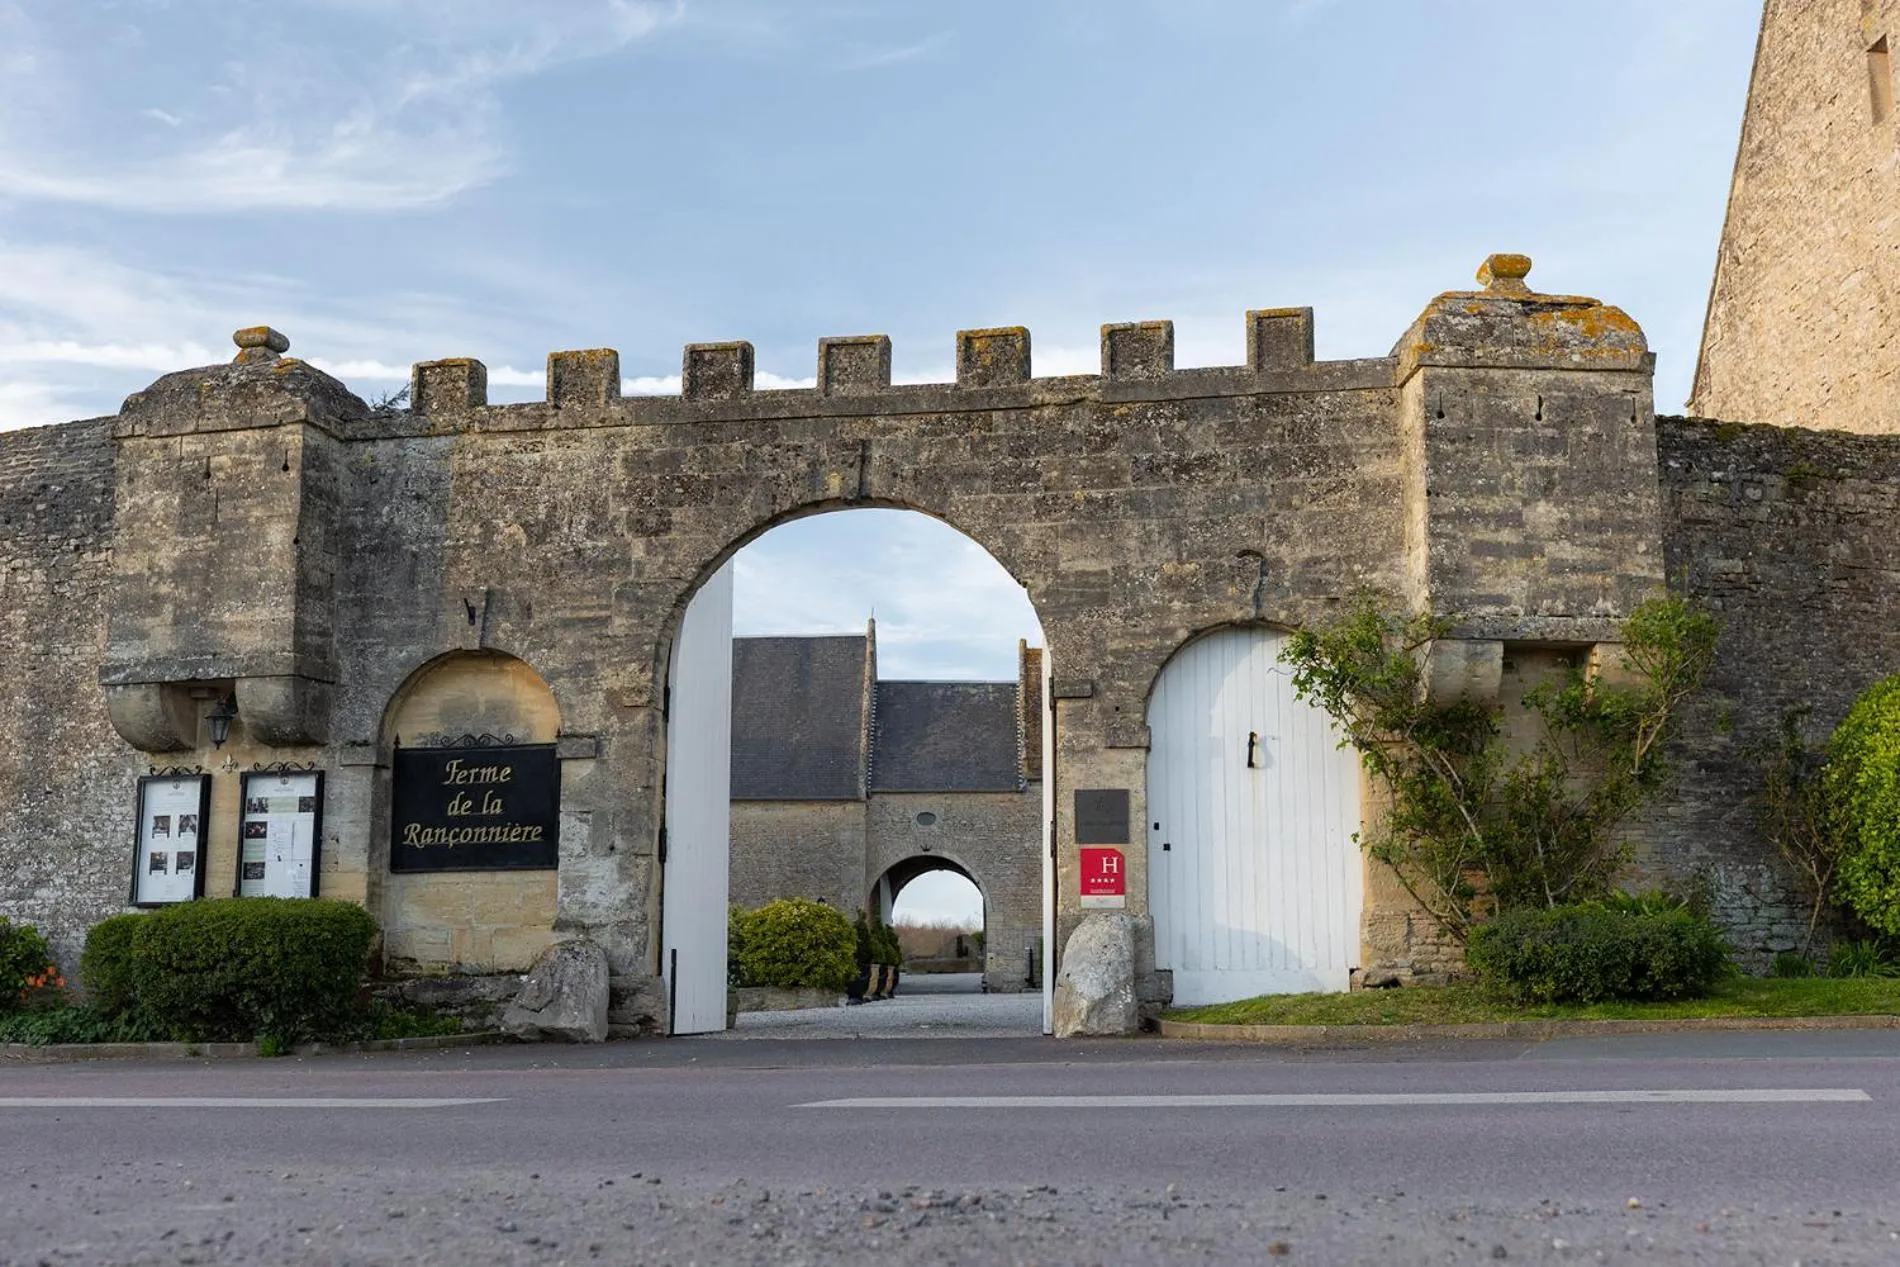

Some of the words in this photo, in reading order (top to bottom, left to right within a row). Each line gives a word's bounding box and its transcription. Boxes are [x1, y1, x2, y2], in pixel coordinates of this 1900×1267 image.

[443, 759, 512, 785] Ferme
[447, 791, 472, 816] de
[482, 790, 504, 815] la
[403, 822, 543, 849] Rançonnière
[1101, 856, 1119, 874] H
